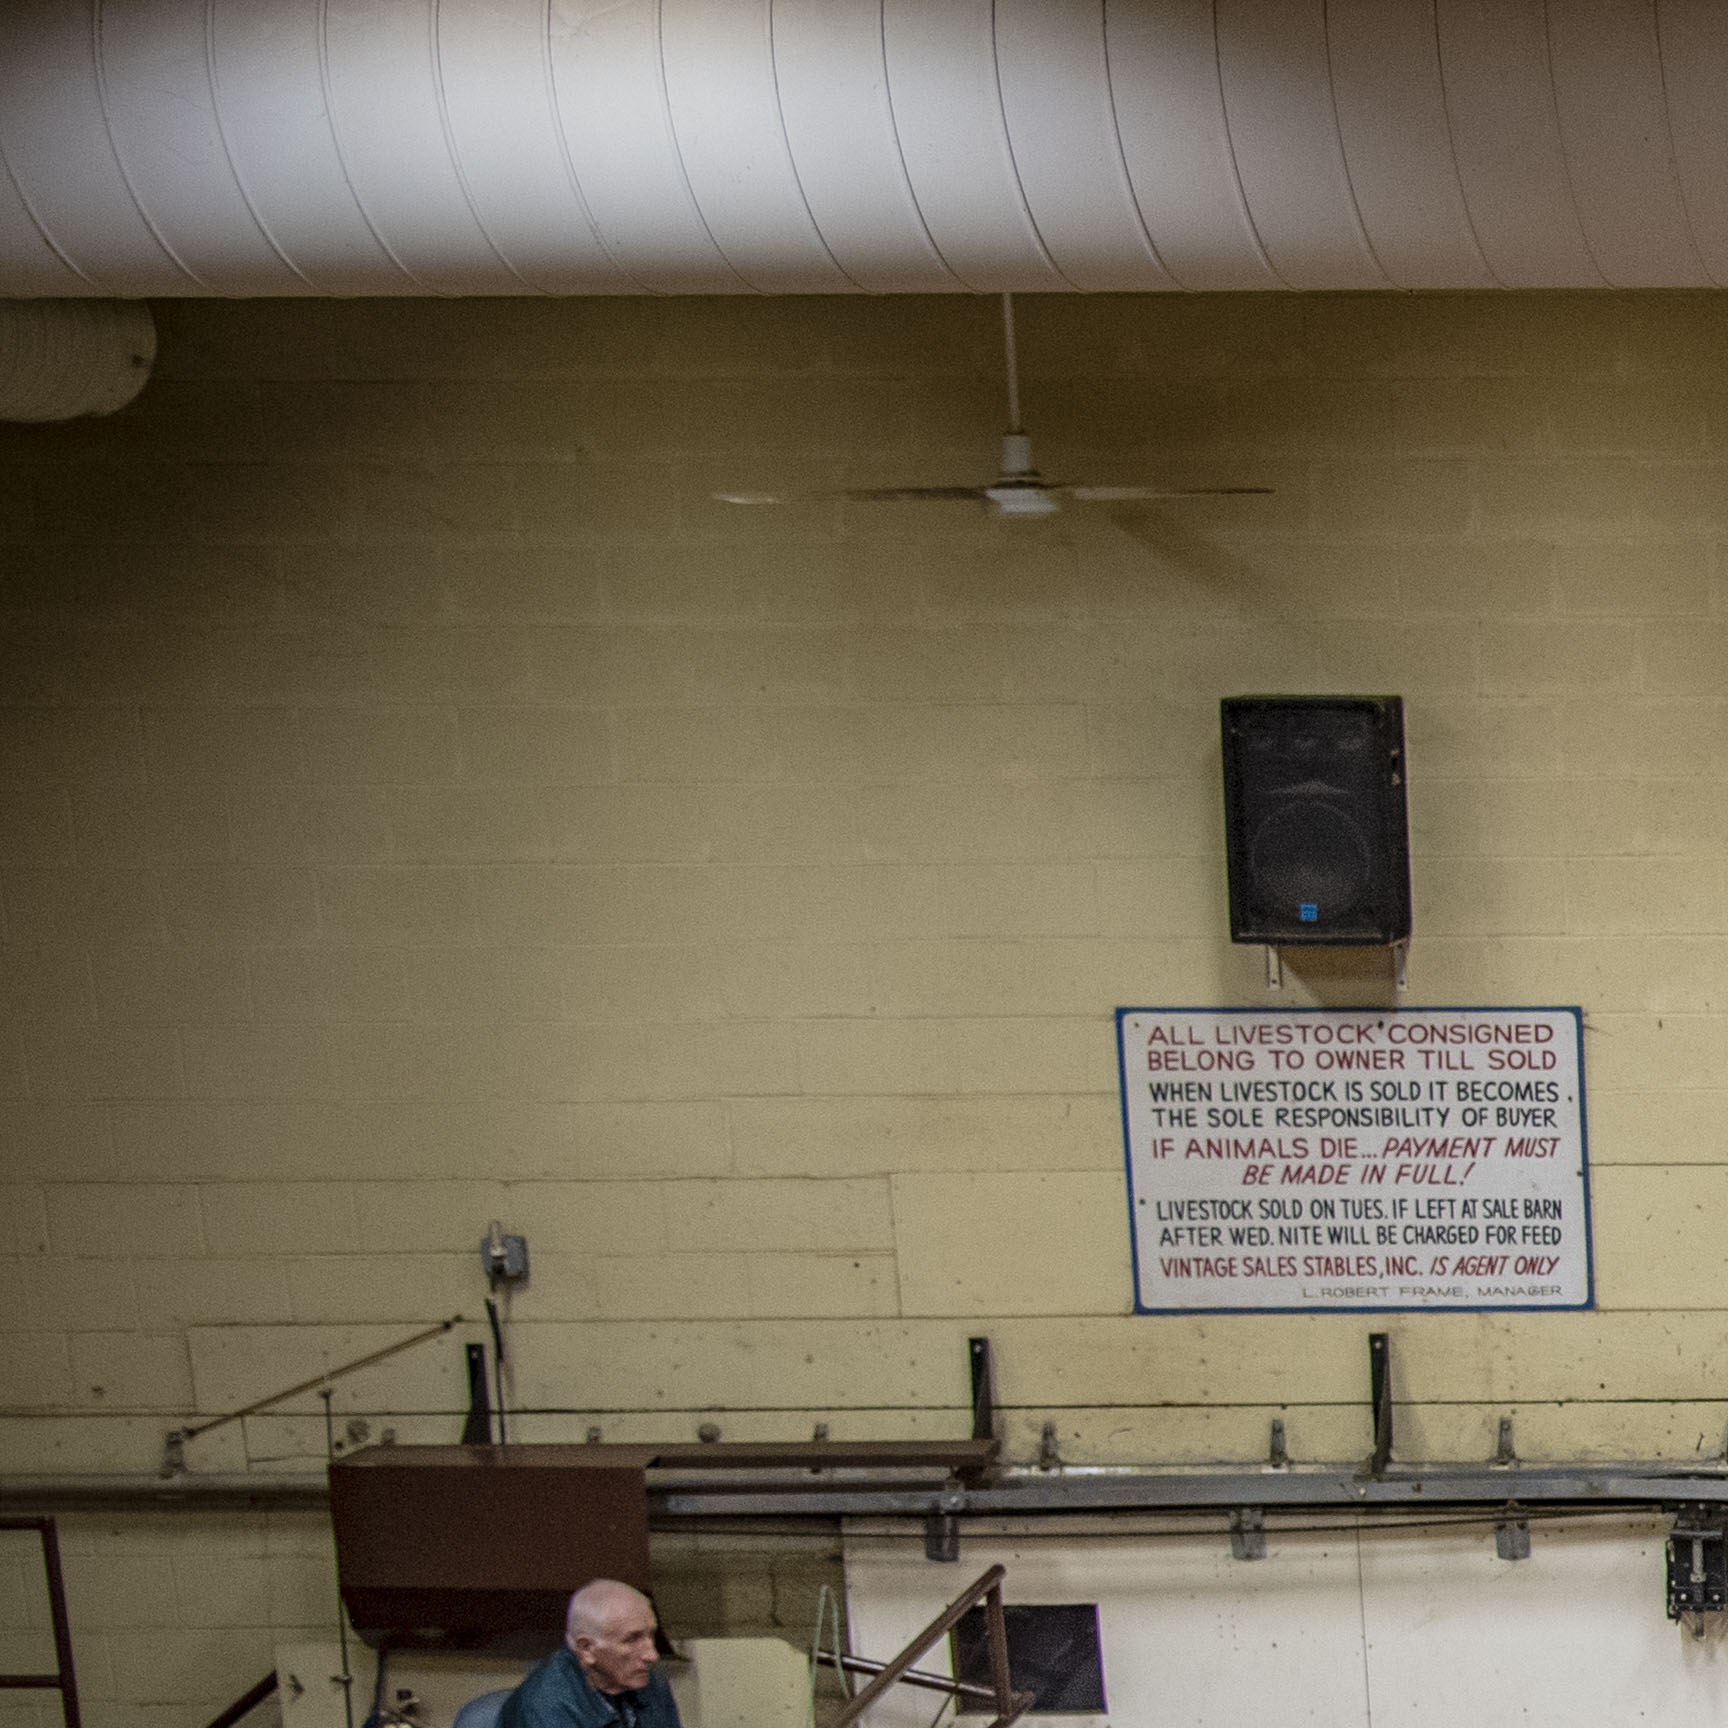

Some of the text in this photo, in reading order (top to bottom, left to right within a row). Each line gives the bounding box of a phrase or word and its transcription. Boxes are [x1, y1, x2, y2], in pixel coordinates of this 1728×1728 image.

[1148, 1024, 1553, 1045] ALL LIVESTOCK CONSIGNED
[1148, 1050, 1556, 1071] BELONG TO OWNER TILL SOLD
[1149, 1081, 1559, 1103] WHEN LIVESTOCK IS SOLD IT BECOMES
[1152, 1107, 1558, 1128] THE SOLE RESPONSIBILITY OF BUYER
[1152, 1138, 1174, 1159] IF
[1185, 1138, 1309, 1159] ANIMALS
[1504, 1137, 1560, 1158] MUST
[1242, 1161, 1476, 1186] BE MADE IN FULL!
[1156, 1199, 1563, 1221] LIVESTOCK SOLD ON TUES. IF LEFT AT SALE BARN
[1160, 1225, 1562, 1247] AFTER WED. NITE WILL BE CHARGED FOR FEED
[1160, 1256, 1238, 1278] VINTAGE
[1243, 1256, 1298, 1277] SALES
[1430, 1256, 1449, 1276] IS
[1452, 1256, 1510, 1276] AGENT
[1514, 1256, 1560, 1276] ONLY
[1302, 1285, 1563, 1299] L. ROBERT FRAME, MANAGER
